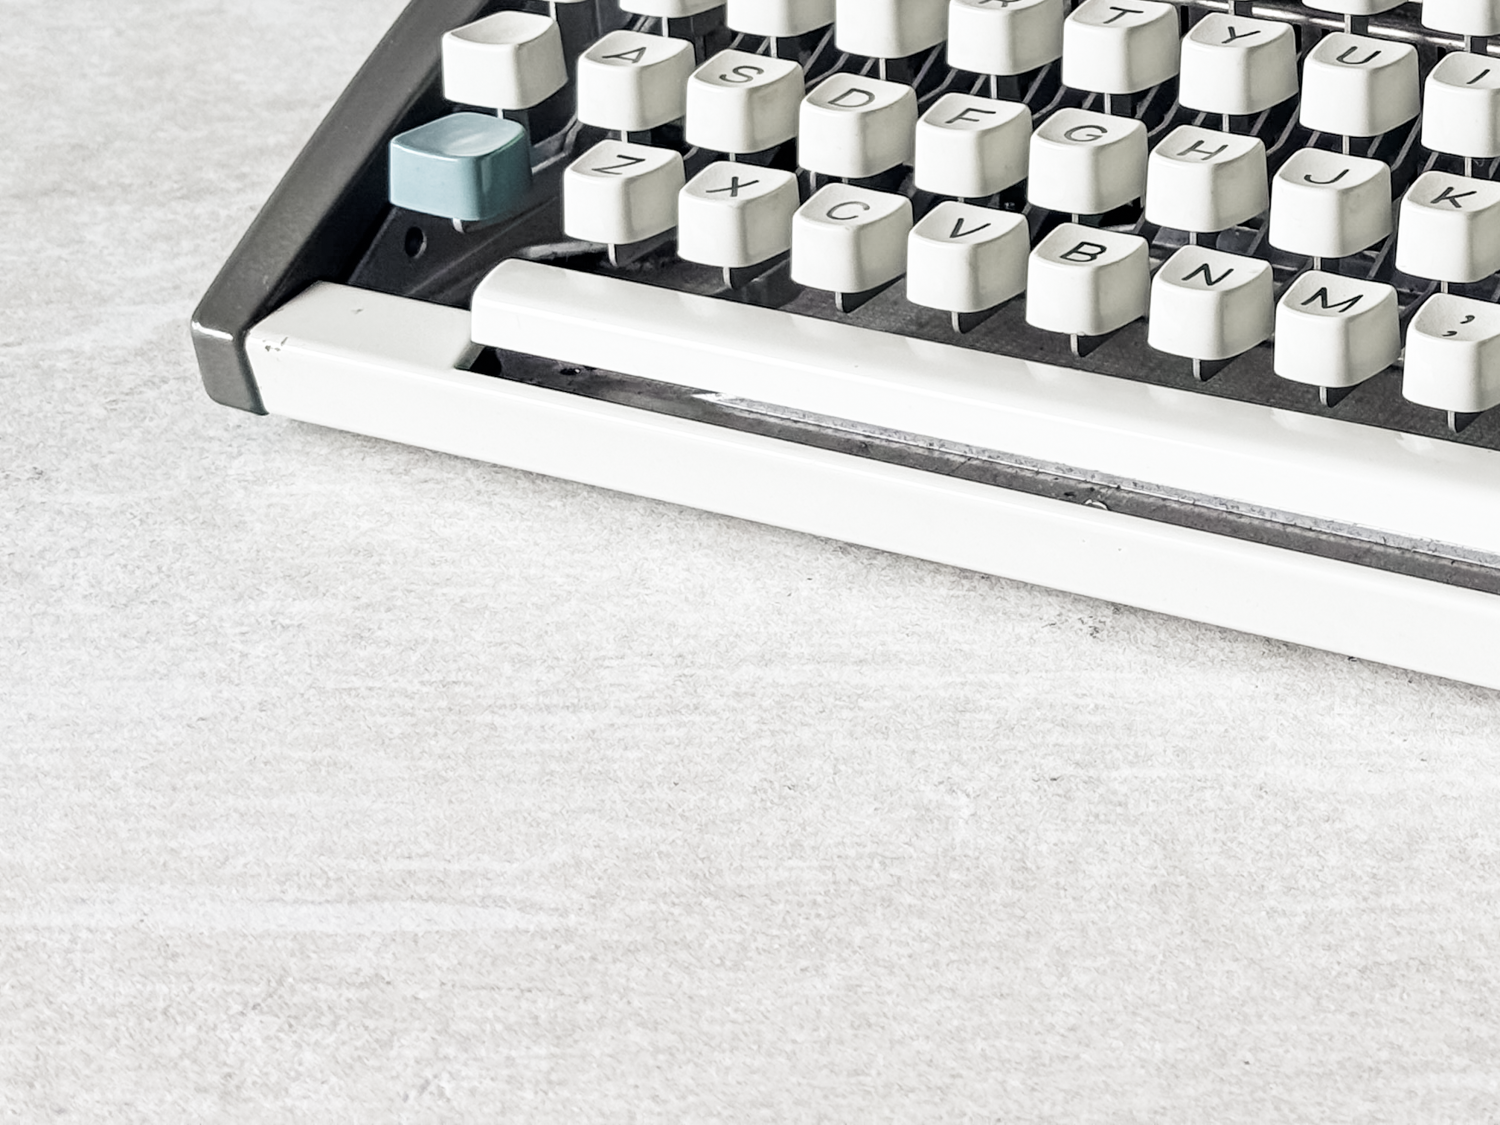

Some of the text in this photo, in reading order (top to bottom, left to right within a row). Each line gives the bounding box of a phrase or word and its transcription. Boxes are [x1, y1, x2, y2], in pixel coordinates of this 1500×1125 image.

[1103, 6, 1144, 24] T
[1221, 26, 1261, 44] Y
[601, 47, 646, 63] A
[1336, 46, 1381, 64] U
[719, 65, 764, 83] S
[827, 88, 875, 108] D
[945, 108, 996, 124] F
[1064, 125, 1108, 142] G
[1177, 140, 1228, 160] H
[591, 154, 646, 175] Z
[1304, 169, 1349, 184] J
[706, 176, 759, 197] X
[1430, 187, 1477, 208] K
[826, 201, 870, 220] C
[949, 218, 991, 238] V
[1059, 241, 1107, 262] B
[1181, 263, 1234, 286] N
[1301, 286, 1363, 313] M
